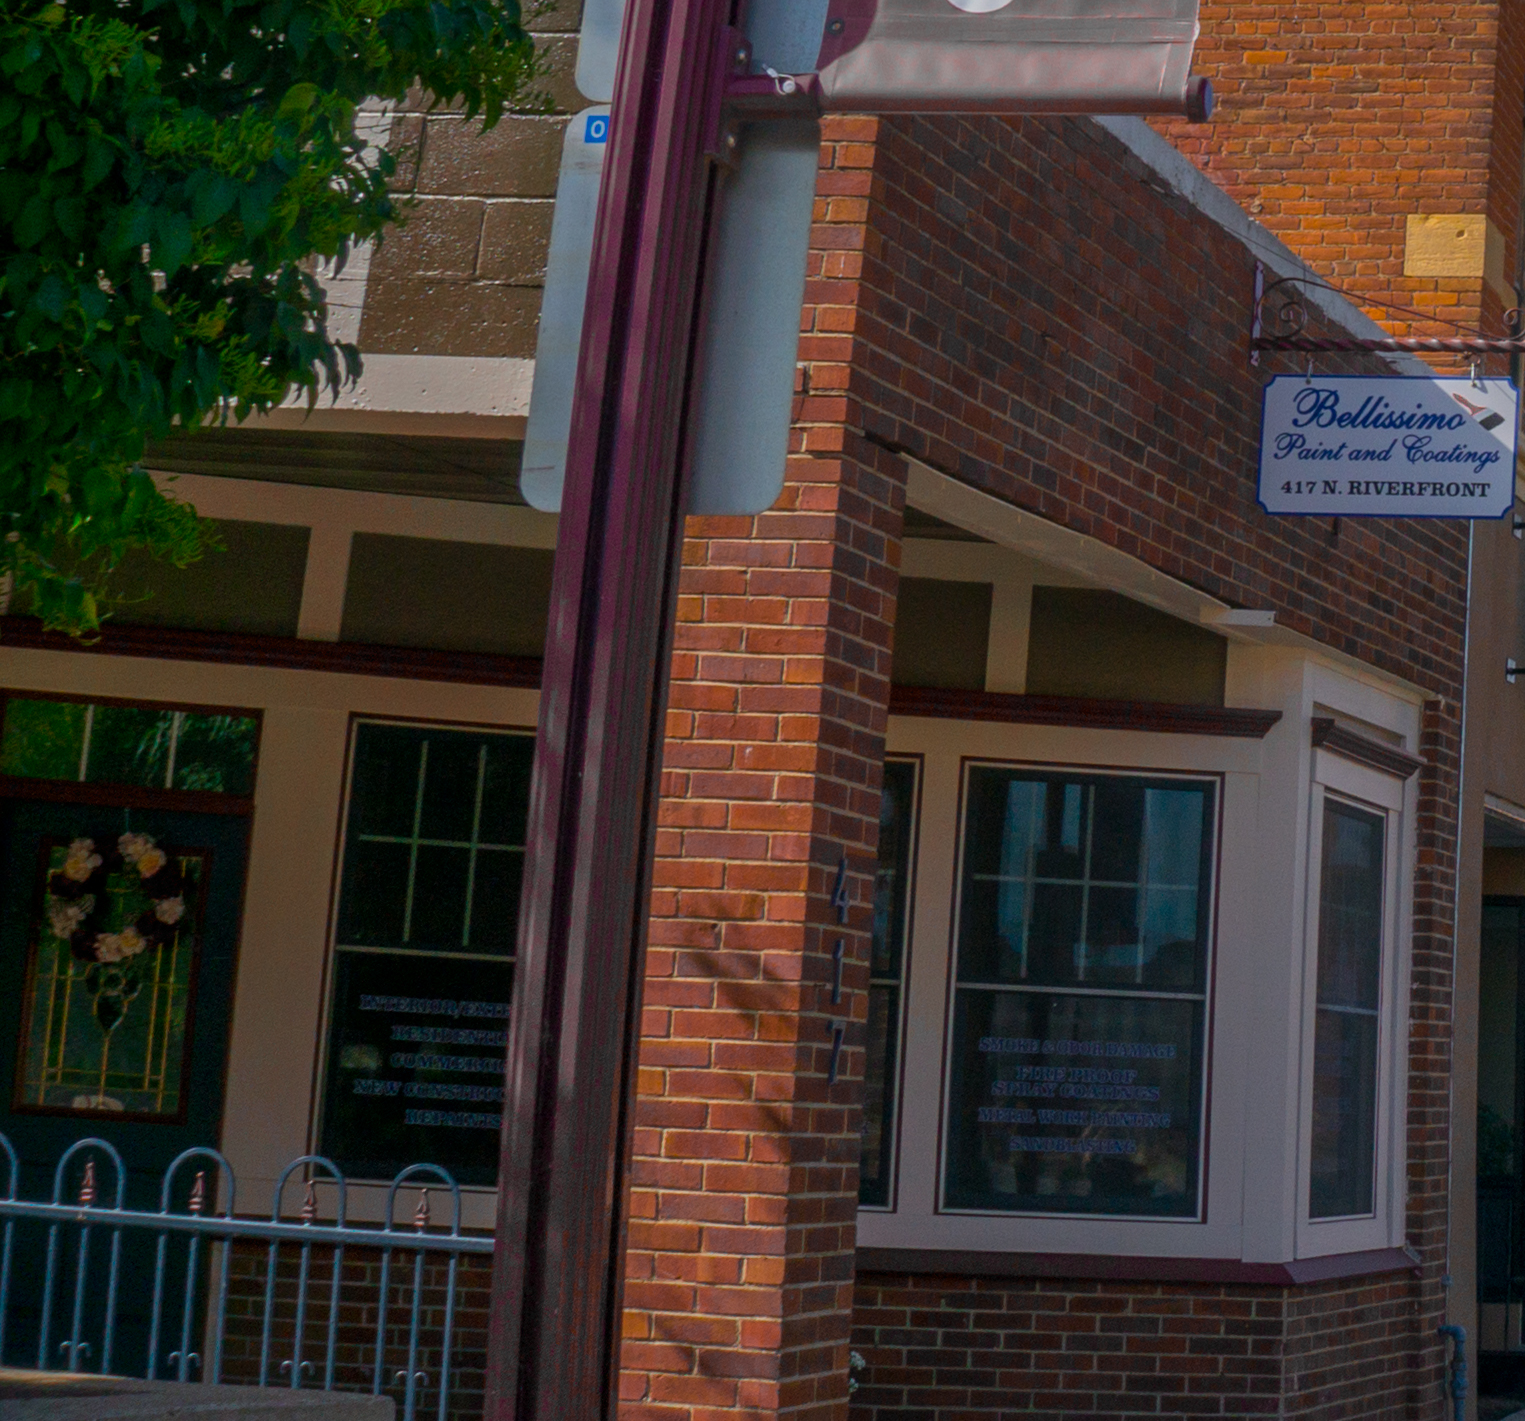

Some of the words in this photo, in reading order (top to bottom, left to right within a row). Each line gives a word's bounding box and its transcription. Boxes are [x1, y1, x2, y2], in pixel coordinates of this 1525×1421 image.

[1291, 387, 1467, 429] Bellissimo
[1273, 432, 1347, 460] Paint
[1348, 438, 1398, 461] and
[1402, 434, 1500, 473] Coatings
[1281, 481, 1316, 494] 417
[1322, 481, 1342, 495] N.
[1348, 481, 1491, 497] RIVERFRONT
[978, 1037, 1040, 1054] SMOKE
[1041, 1040, 1054, 1055] &
[1056, 1040, 1102, 1056] ODOR
[1105, 1041, 1178, 1059] DAMAGE
[1016, 1065, 1067, 1081] FIRE
[1068, 1067, 1138, 1084] PROOF
[353, 1079, 401, 1096] NEW
[991, 1080, 1059, 1097] SPRAY
[1059, 1083, 1160, 1102] COATINGS
[977, 1107, 1036, 1124] METAL
[1037, 1109, 1090, 1125] WORK
[1090, 1111, 1171, 1128] PAINTING
[1009, 1135, 1136, 1154] SANDBLASTING
